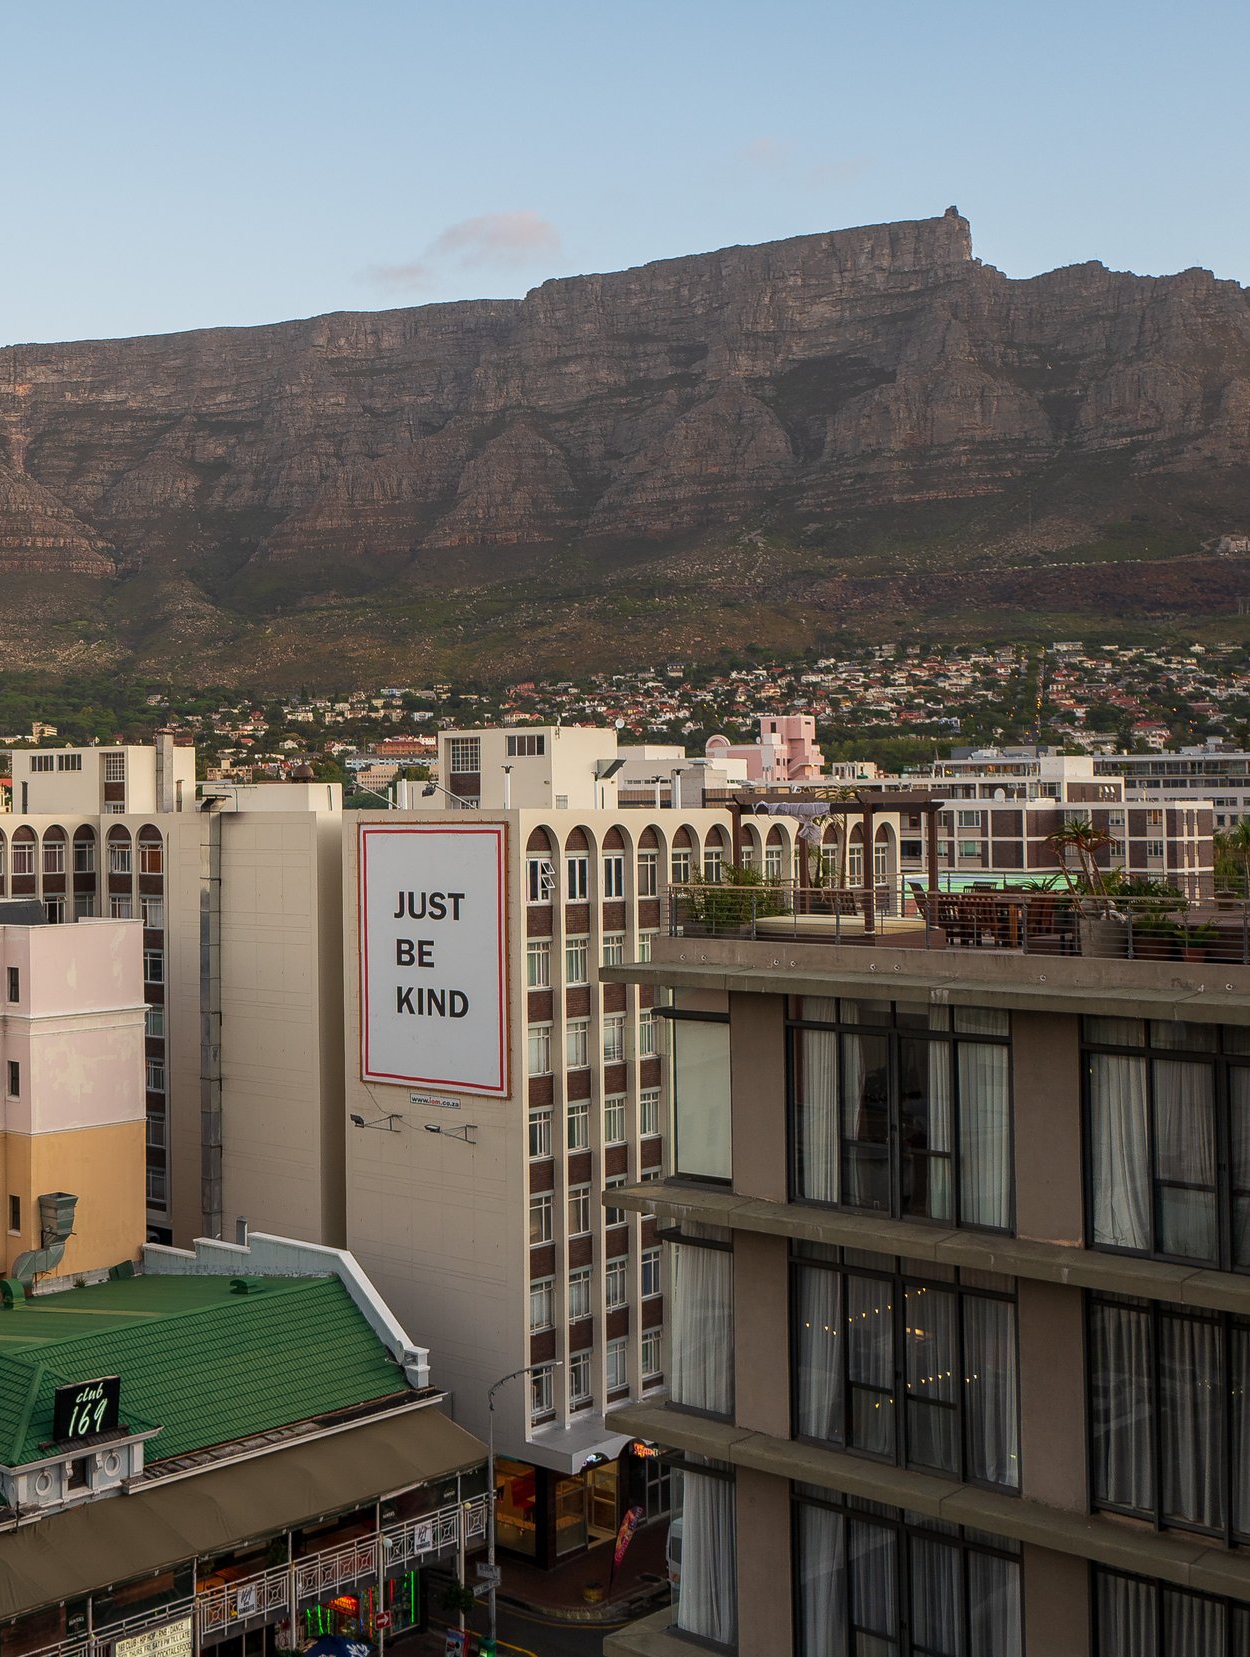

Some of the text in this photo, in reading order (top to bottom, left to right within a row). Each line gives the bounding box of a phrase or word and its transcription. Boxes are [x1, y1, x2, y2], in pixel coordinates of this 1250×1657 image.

[394, 891, 465, 921] JUST
[396, 938, 435, 968] BE
[397, 986, 469, 1018] KIND
[411, 1096, 459, 1108] www.iom.co.za
[76, 1382, 104, 1403] club
[68, 1397, 108, 1437] 169
[170, 1622, 184, 1633] DANCE
[180, 1630, 190, 1640] LATE
